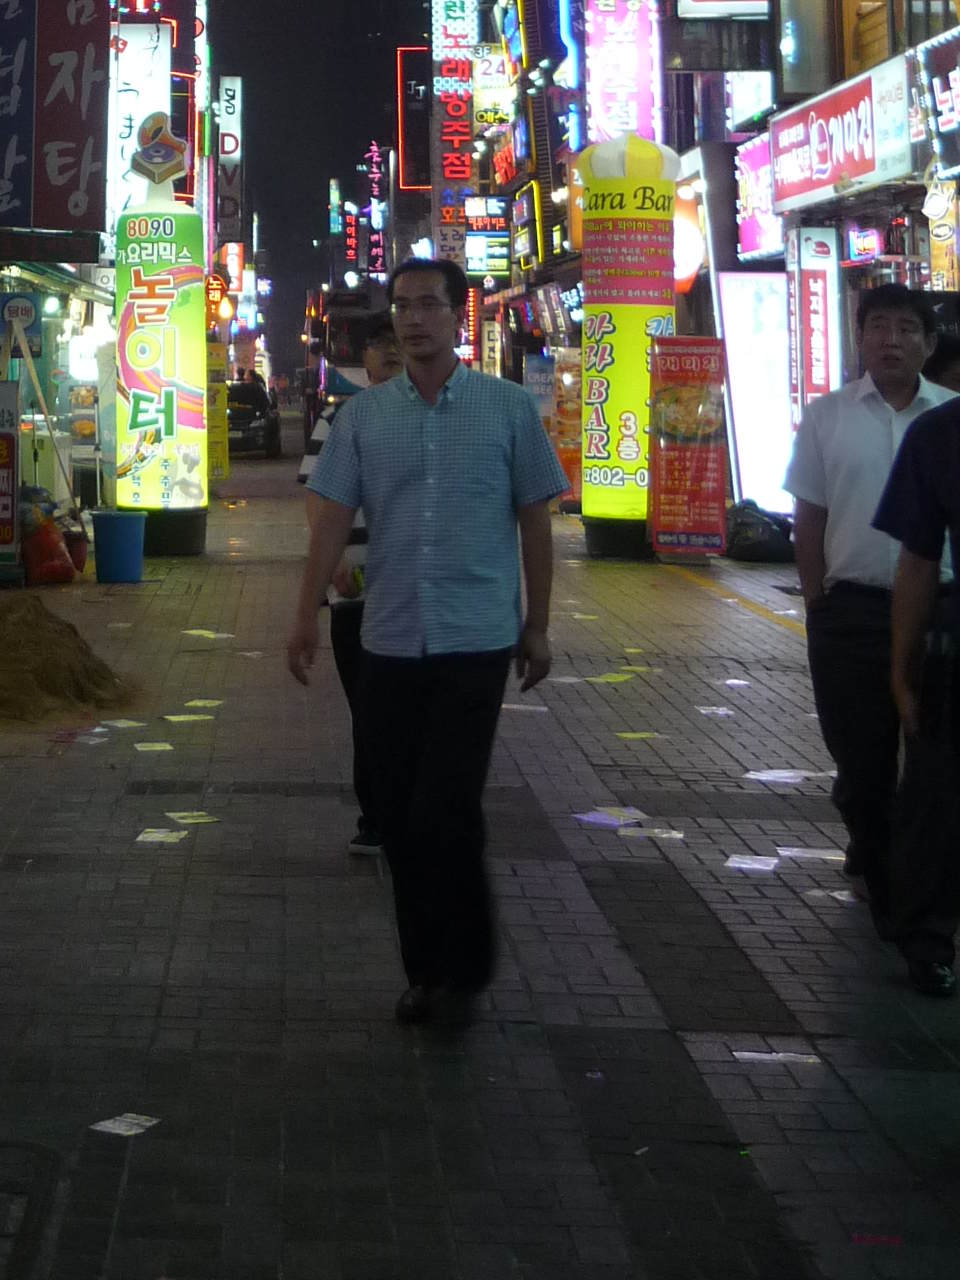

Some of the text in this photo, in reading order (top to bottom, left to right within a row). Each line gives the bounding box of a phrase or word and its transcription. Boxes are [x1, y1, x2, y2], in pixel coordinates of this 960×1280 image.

[441, 24, 472, 180] 노래방주점
[634, 186, 673, 212] Bar
[117, 242, 193, 265] 가요리믹스
[126, 218, 175, 238] 8090
[126, 268, 179, 440] 놀이터
[585, 376, 610, 460] BAR
[617, 410, 640, 461] 3층
